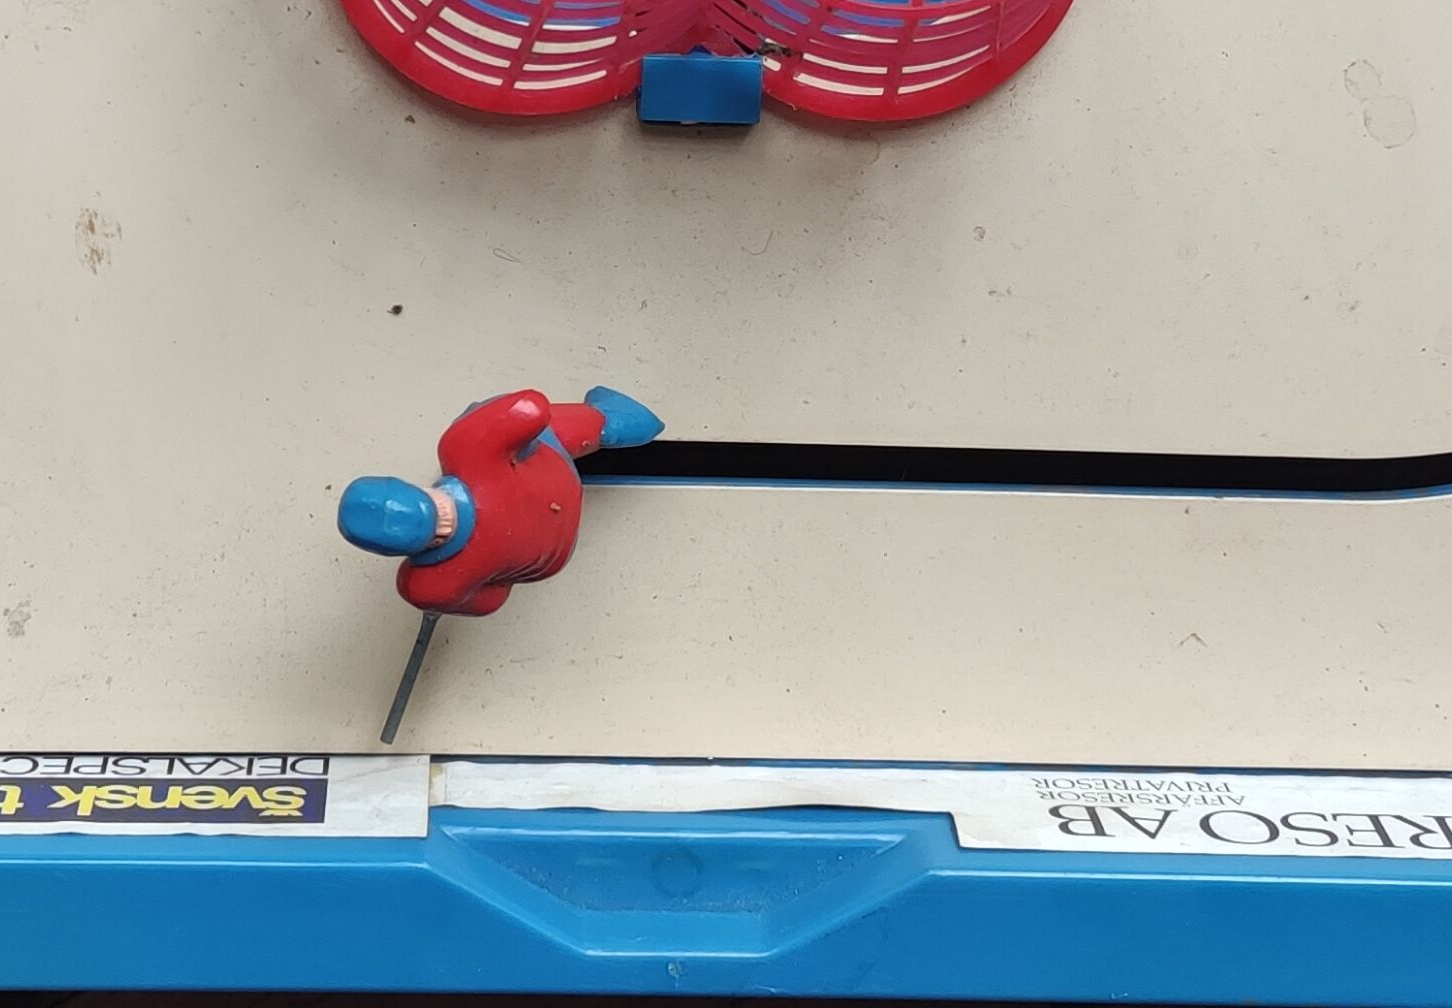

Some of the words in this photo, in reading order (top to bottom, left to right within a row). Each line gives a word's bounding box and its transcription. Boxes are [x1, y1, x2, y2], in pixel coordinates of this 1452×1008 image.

[1031, 777, 1230, 793] PRIVATRESOR
[1038, 789, 1245, 807] AFFÄRSRESOR
[1047, 804, 1177, 840] AB
